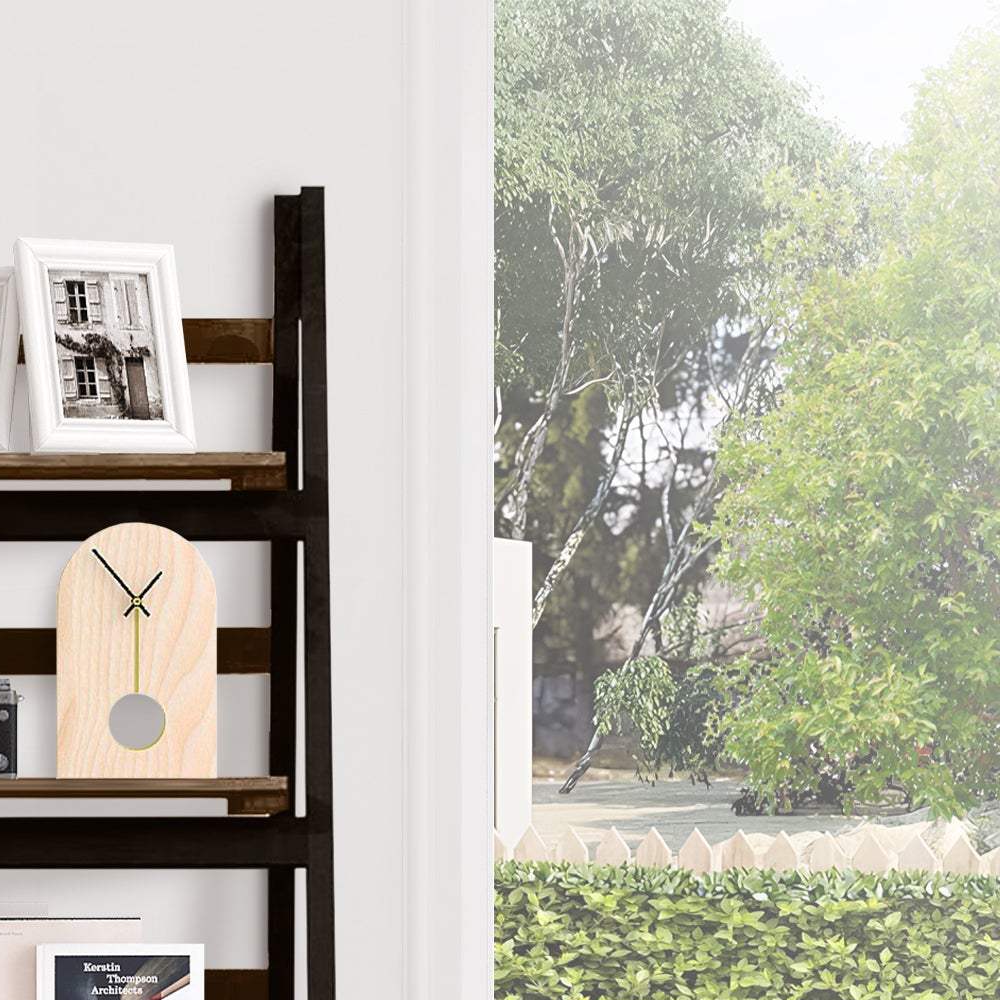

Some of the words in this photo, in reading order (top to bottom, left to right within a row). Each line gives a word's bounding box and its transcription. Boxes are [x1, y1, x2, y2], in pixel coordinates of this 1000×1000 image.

[83, 962, 121, 972] Kerstin
[106, 974, 158, 985] Thompson
[91, 985, 143, 995] Architects
